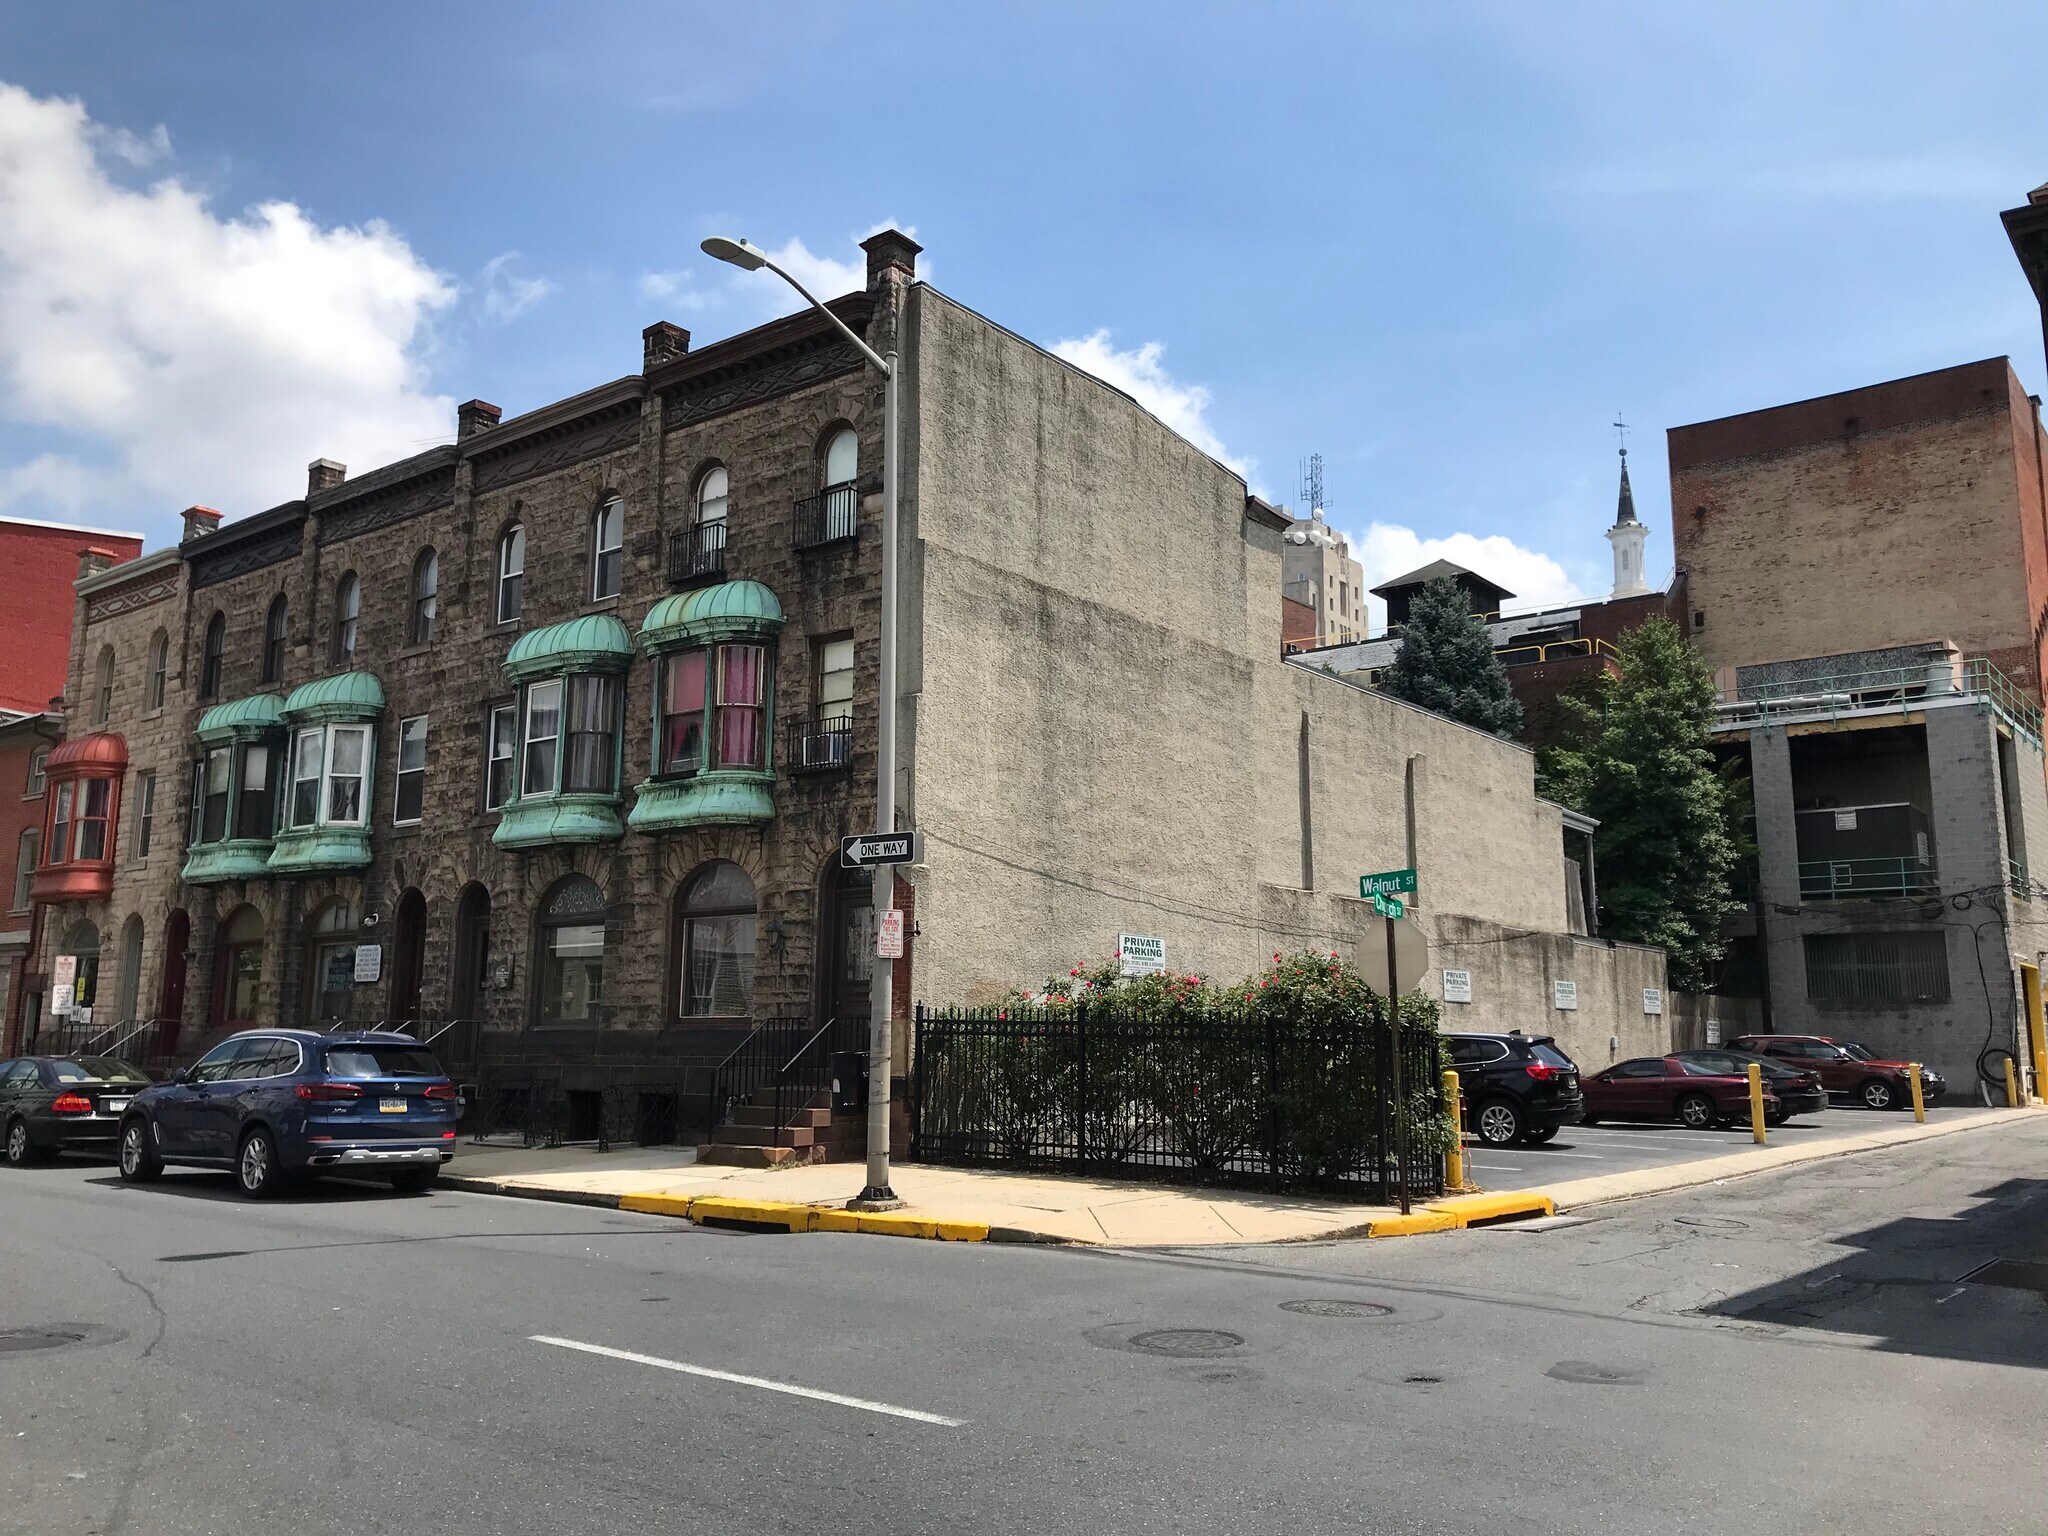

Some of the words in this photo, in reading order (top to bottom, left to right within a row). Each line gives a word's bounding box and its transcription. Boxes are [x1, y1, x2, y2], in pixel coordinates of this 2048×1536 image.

[861, 844, 880, 856] ONE
[883, 842, 905, 855] WAY
[1362, 877, 1401, 894] Walnut
[1405, 876, 1414, 885] ST
[1124, 936, 1161, 949] PRIVATE
[1123, 946, 1162, 957] PARKING
[1446, 972, 1468, 980] PRIVATE
[1445, 978, 1469, 987] PARKING
